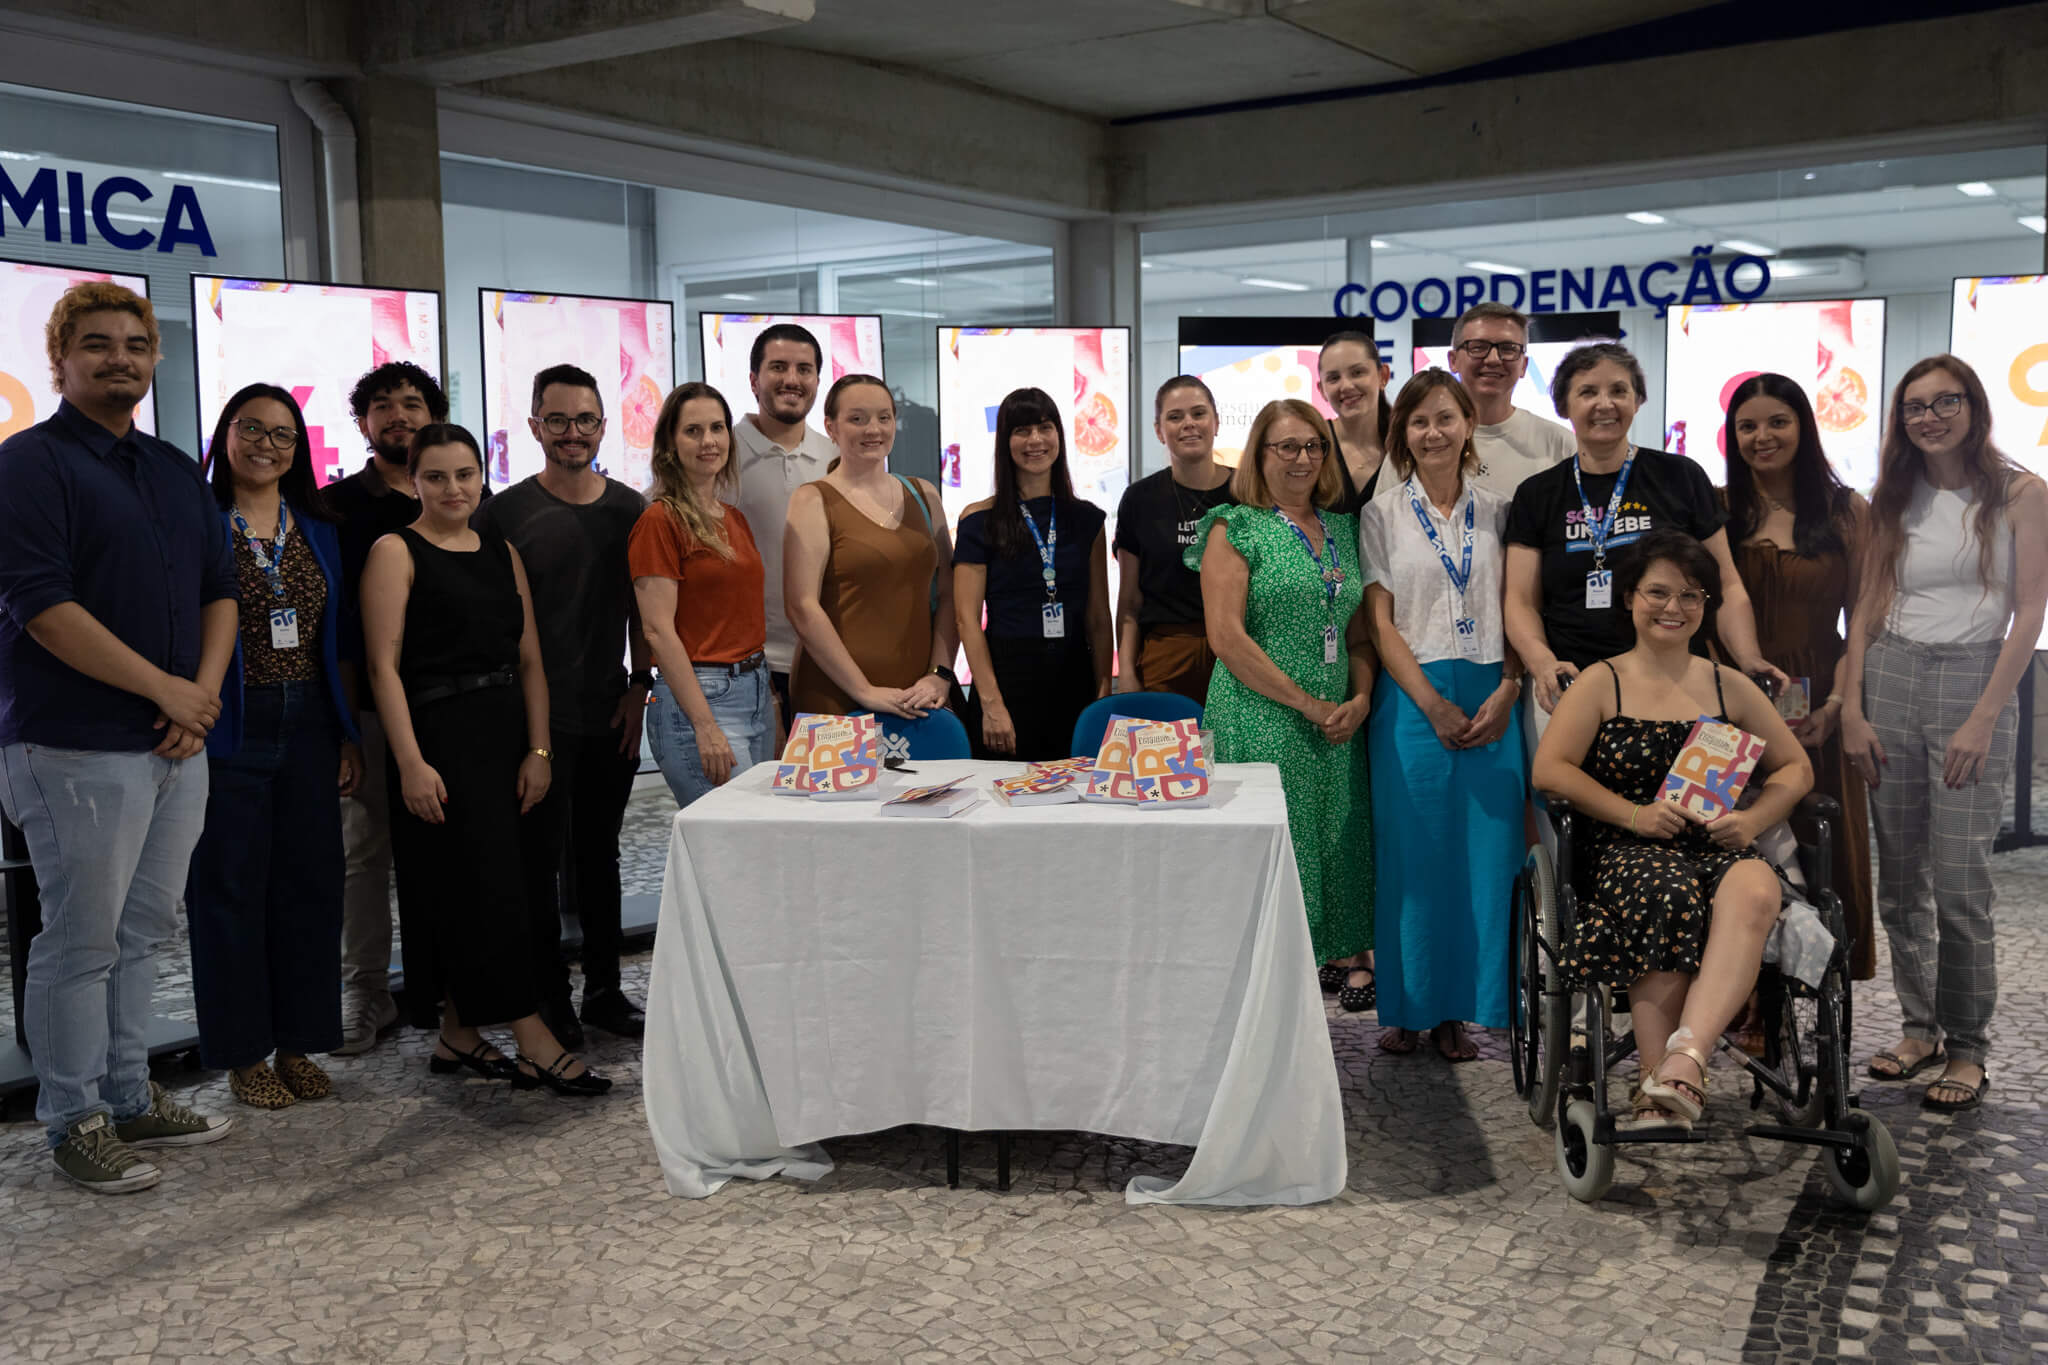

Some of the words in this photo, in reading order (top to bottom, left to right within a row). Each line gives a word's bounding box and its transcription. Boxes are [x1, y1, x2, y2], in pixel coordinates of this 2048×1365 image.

[0, 162, 218, 258] MICA
[1333, 245, 1771, 322] COORDENAÇÃO
[1177, 519, 1199, 532] LET
[1565, 515, 1652, 540] UNEBE
